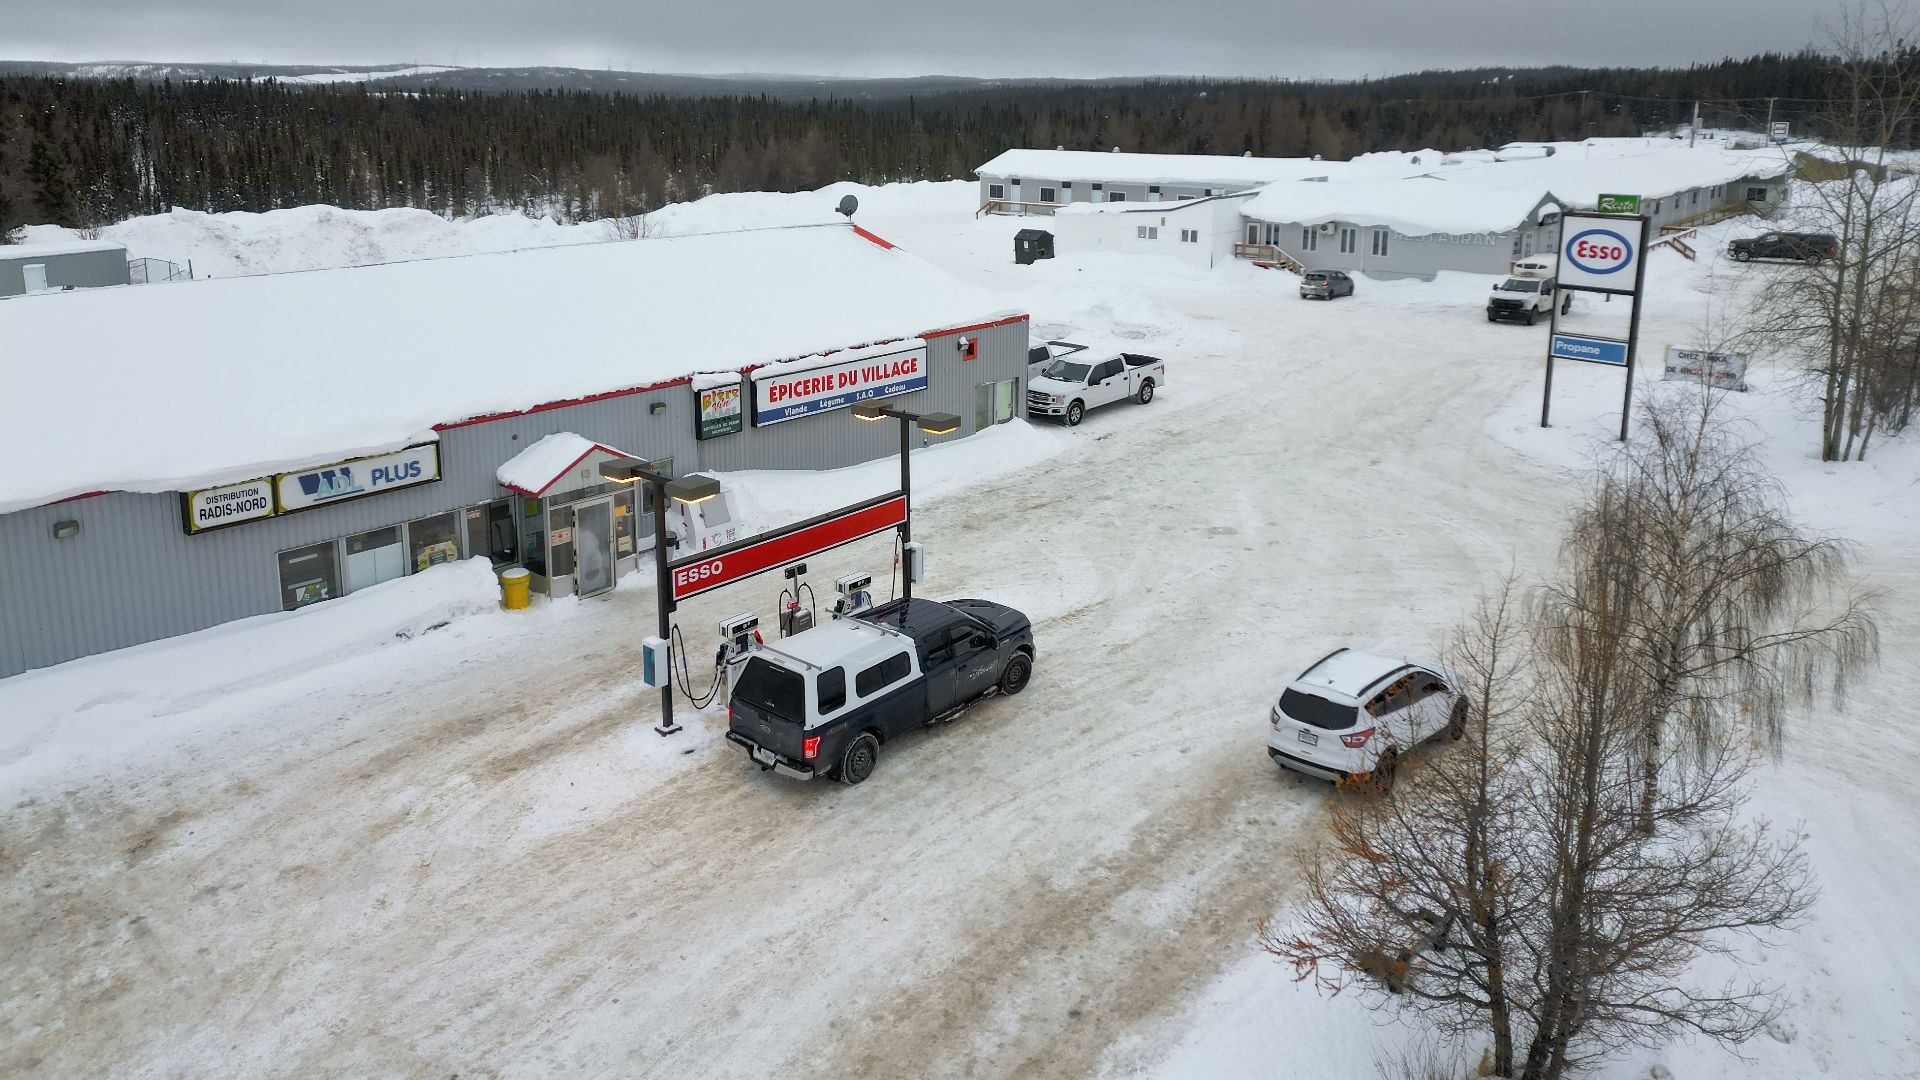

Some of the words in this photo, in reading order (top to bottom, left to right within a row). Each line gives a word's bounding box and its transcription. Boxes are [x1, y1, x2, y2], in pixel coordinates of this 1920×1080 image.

[1555, 340, 1601, 355] Propane
[769, 381, 834, 403] ÉPICERIE
[838, 369, 857, 389] DU
[861, 357, 918, 383] VILLAGE
[784, 404, 808, 416] Viande
[819, 398, 845, 408] Légume
[884, 383, 906, 394] Cadeau
[371, 460, 421, 487] PLUS
[200, 496, 267, 521] RADIS-NORD
[205, 487, 259, 505] DISTRIBUTION
[677, 560, 723, 586] ESSO
